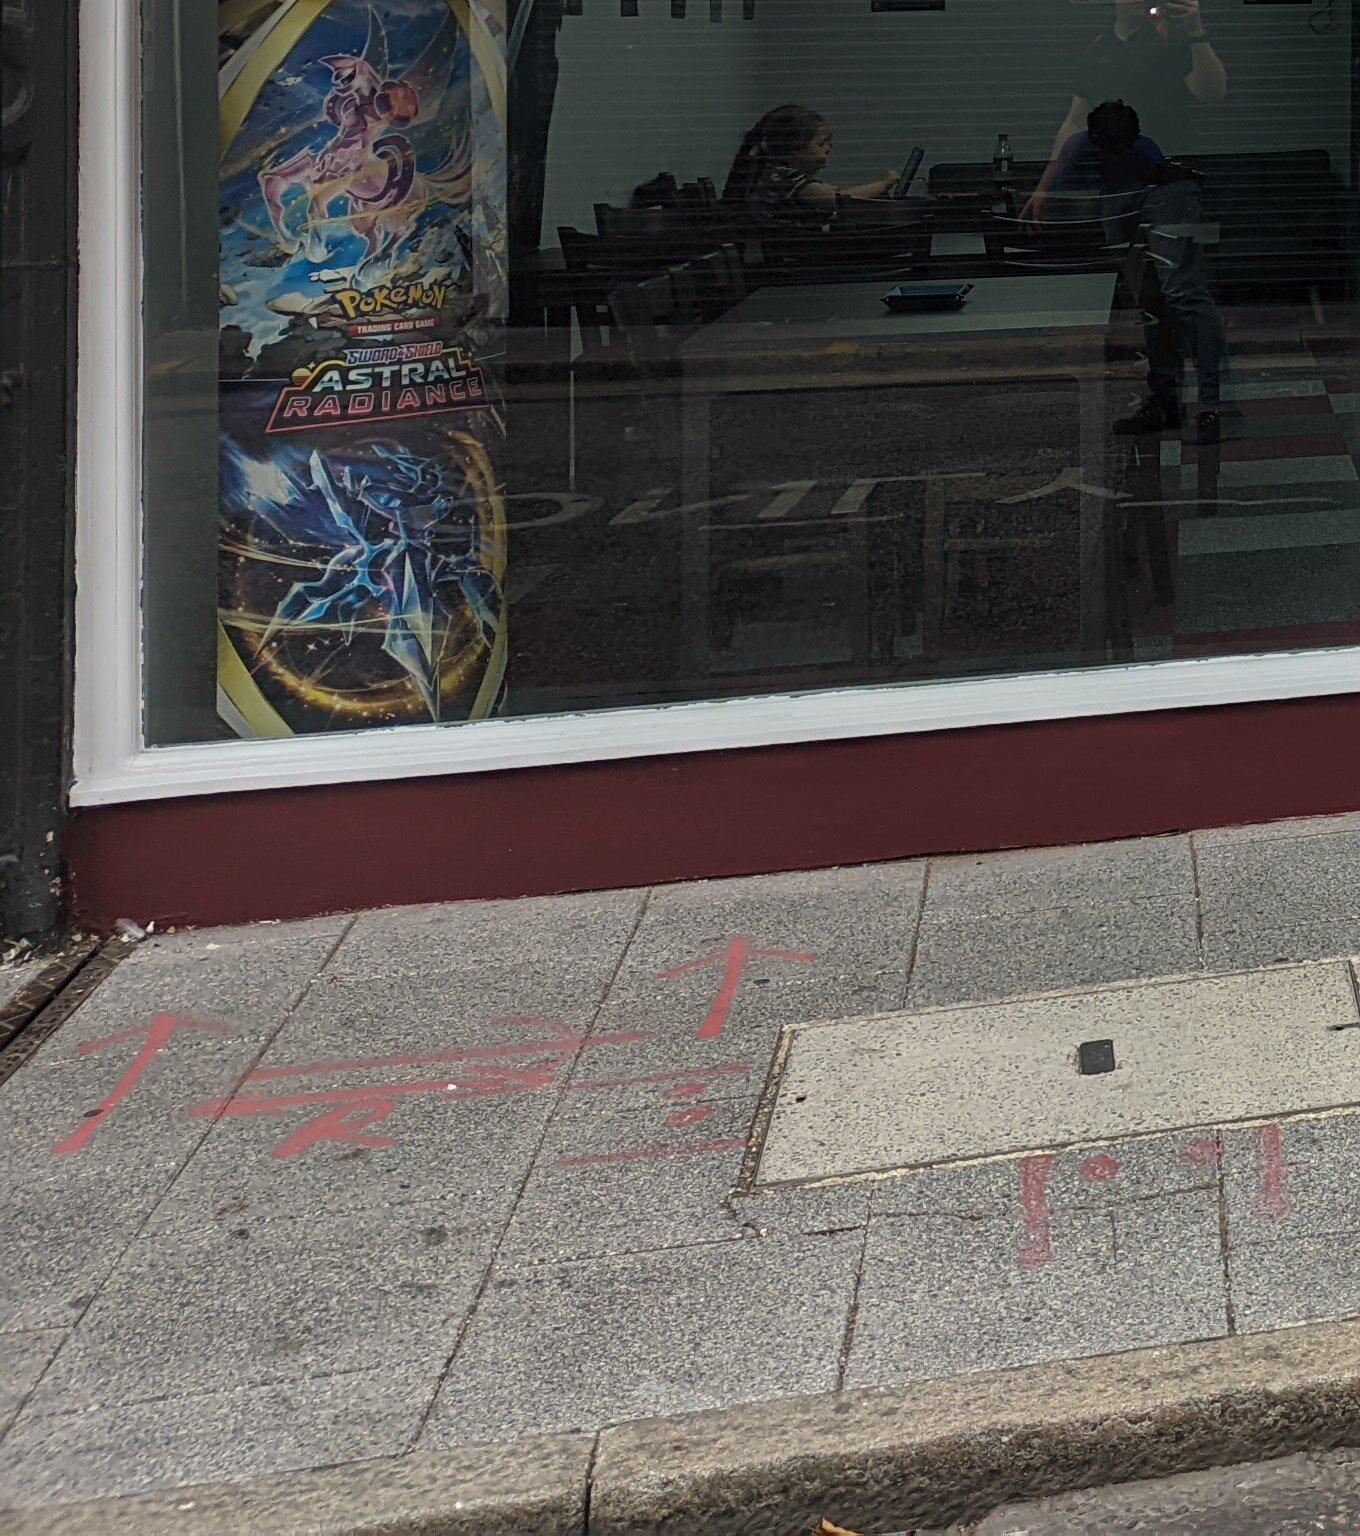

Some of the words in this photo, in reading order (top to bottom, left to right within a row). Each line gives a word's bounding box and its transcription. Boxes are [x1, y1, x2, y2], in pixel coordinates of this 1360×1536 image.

[349, 346, 396, 364] SWORD
[405, 342, 443, 361] SHIELD
[312, 356, 467, 393] ASTRAL
[283, 377, 482, 417] RADIANCE
